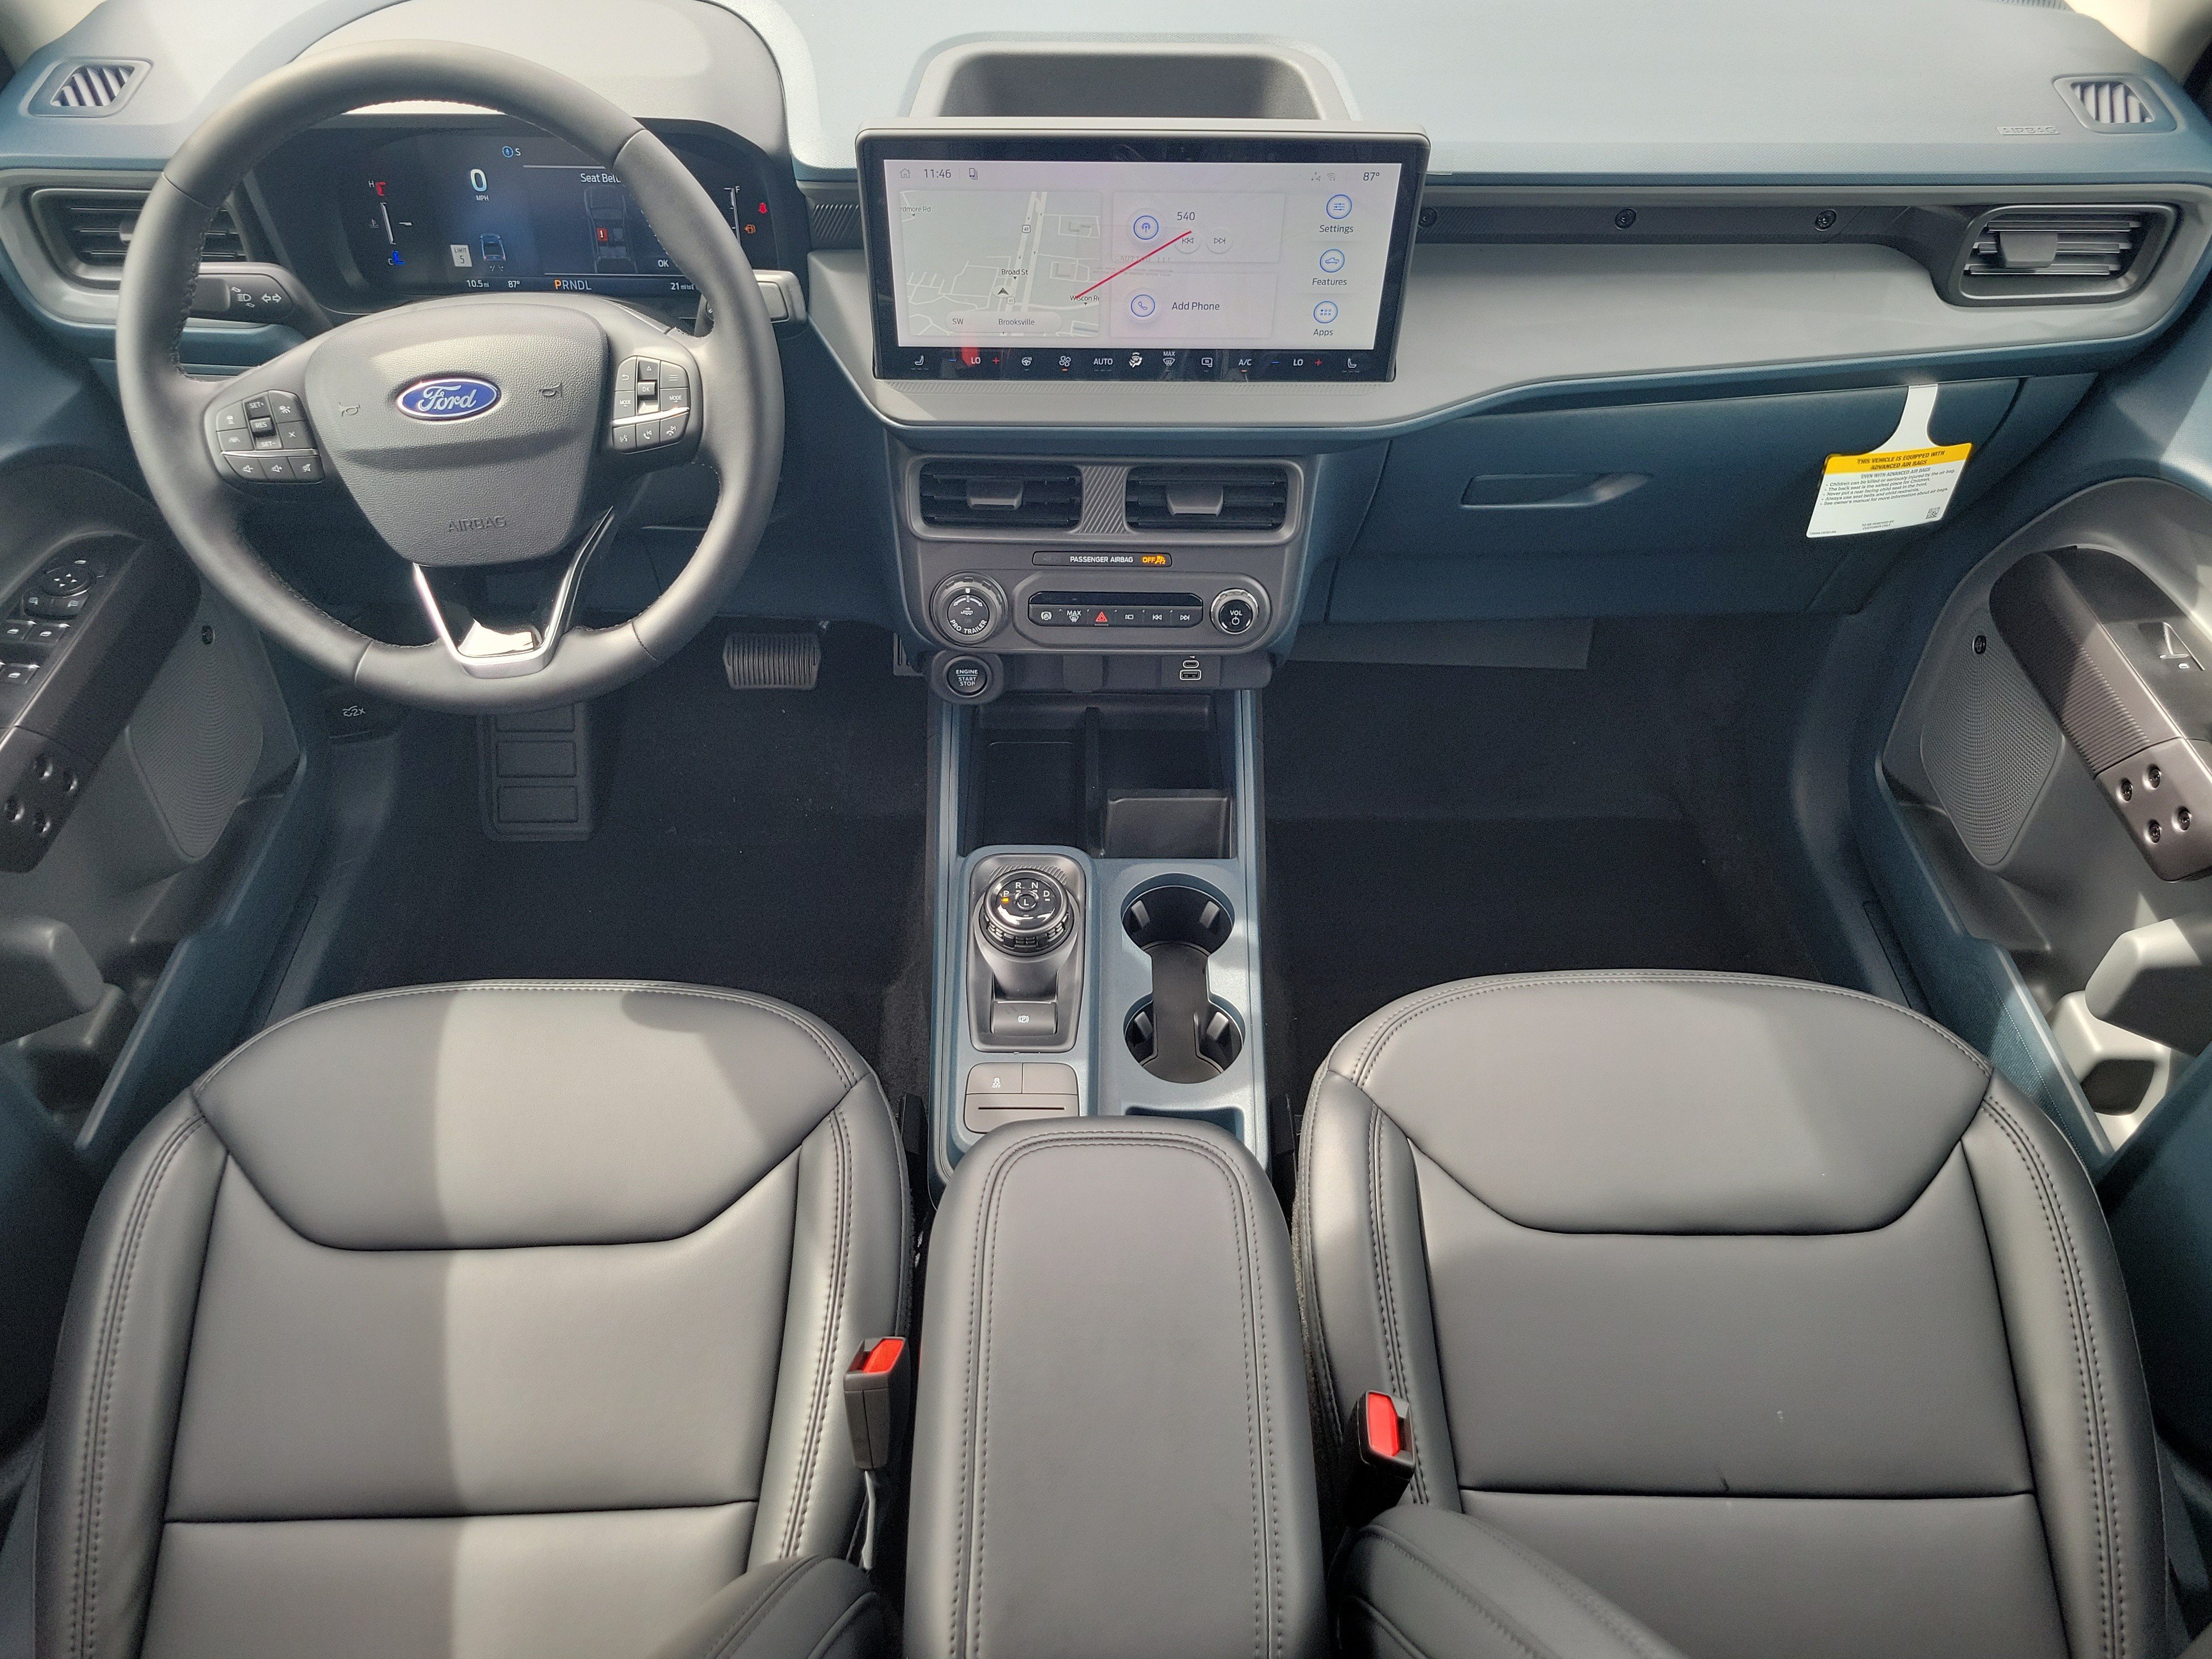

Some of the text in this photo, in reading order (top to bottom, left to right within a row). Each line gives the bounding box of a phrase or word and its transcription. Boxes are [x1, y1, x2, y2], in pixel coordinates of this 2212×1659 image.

[924, 168, 951, 178] 11:46
[1363, 172, 1380, 181] 87°
[470, 168, 487, 192] 0
[580, 173, 601, 183] Seat
[1177, 212, 1195, 221] 540
[1319, 225, 1353, 234] Settings
[460, 256, 465, 264] 5
[658, 259, 669, 268] OK
[670, 282, 680, 290] 21
[1312, 278, 1347, 286] Features
[1171, 302, 1220, 311] Add Phone
[1313, 328, 1333, 337] Apps
[970, 357, 981, 365] LO
[1238, 358, 1252, 366] A/C
[417, 385, 477, 412] Ford
[448, 515, 507, 533] AIRBAG
[950, 619, 988, 634] PRO TRAILER
